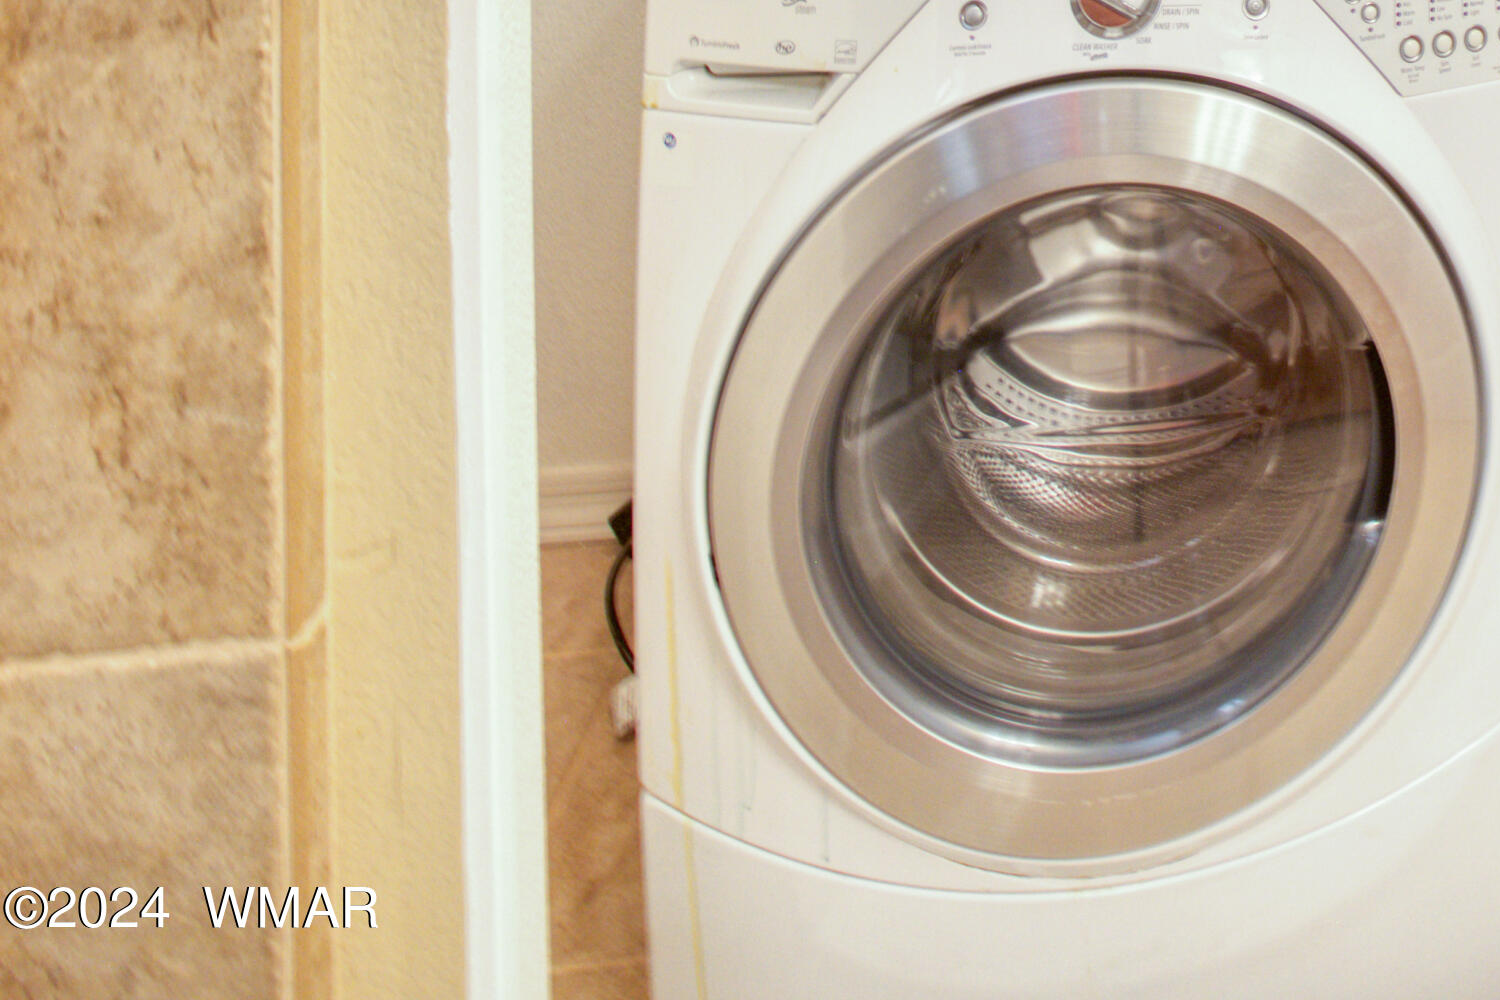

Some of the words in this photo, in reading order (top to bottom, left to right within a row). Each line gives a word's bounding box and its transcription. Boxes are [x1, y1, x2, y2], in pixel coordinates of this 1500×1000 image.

[1162, 8, 1182, 16] DRAIN
[1186, 8, 1200, 16] SPIN
[1153, 22, 1172, 30] RINSE
[1176, 22, 1190, 30] SPIN
[1072, 43, 1092, 51] CLEAN
